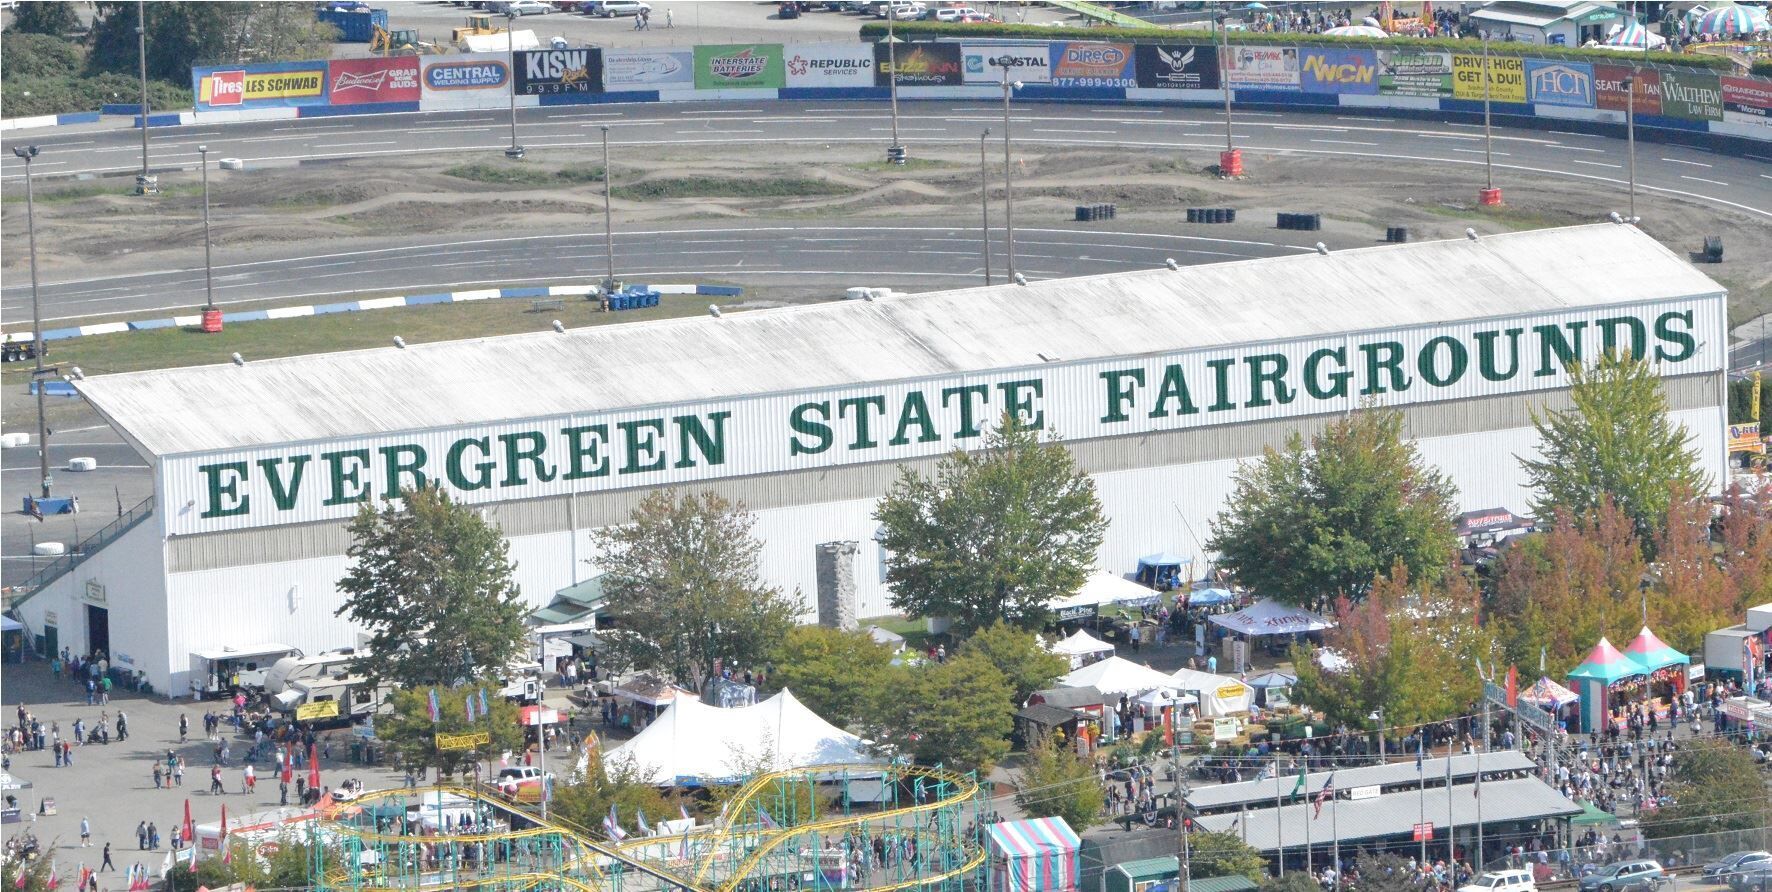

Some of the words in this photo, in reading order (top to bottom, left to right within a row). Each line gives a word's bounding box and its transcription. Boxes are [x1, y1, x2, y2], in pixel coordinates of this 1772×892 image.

[712, 57, 765, 65] INTERSTATE
[1254, 51, 1281, 61] RE/MAX
[1390, 55, 1444, 67] Nelson
[526, 50, 587, 79] KISW
[713, 65, 761, 73] BATTERIES
[809, 59, 871, 68] REPUBLIC
[1493, 58, 1523, 71] HIGH
[389, 69, 417, 77] GRAB
[433, 66, 500, 80] CENTRAL
[1156, 72, 1201, 82] 425
[1458, 71, 1481, 82] GET
[1497, 73, 1522, 86] DUI!
[1665, 73, 1676, 82] The
[213, 77, 242, 97] Tires
[246, 80, 265, 92] LES
[268, 77, 318, 91] SCHWAB
[390, 80, 417, 88] BUDS
[1052, 77, 1136, 87] 877-999-0300
[1541, 71, 1581, 95] HCI
[1595, 79, 1629, 92] SEATT
[1643, 83, 1660, 95] TAN
[1662, 81, 1720, 105] WALTHEW
[1688, 102, 1702, 115] LAW
[1704, 104, 1721, 117] FIRM
[199, 410, 731, 518] EVERGREEN
[789, 378, 1044, 456] STATE
[1099, 309, 1696, 423] FAIRGROUNDS
[1264, 614, 1310, 627] xfinity
[1365, 788, 1379, 796] GATE
